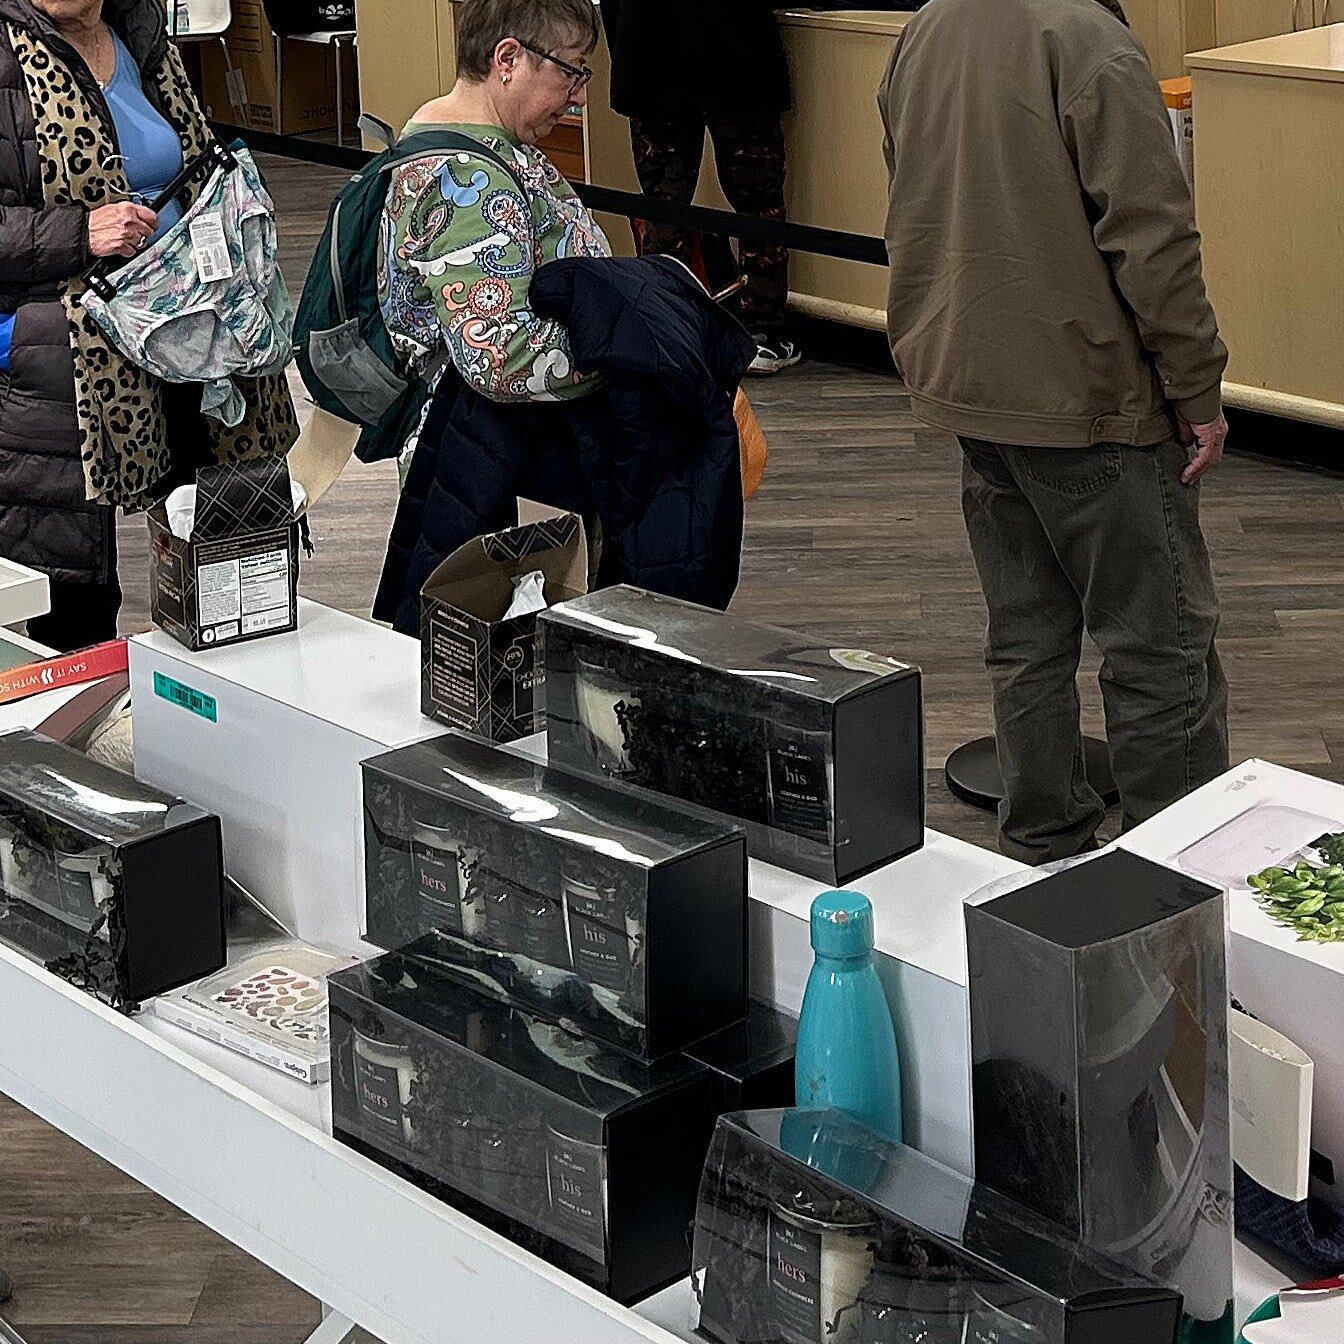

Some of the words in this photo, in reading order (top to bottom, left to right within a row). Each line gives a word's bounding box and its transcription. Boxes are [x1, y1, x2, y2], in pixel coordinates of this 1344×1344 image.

[56, 667, 65, 678] IT
[67, 661, 88, 676] SAY
[12, 675, 41, 691] WITH
[784, 765, 807, 785] his
[420, 868, 448, 893] hers
[583, 923, 606, 944] his
[363, 1082, 388, 1108] hers
[560, 1173, 582, 1197] his
[777, 1251, 806, 1284] hers
